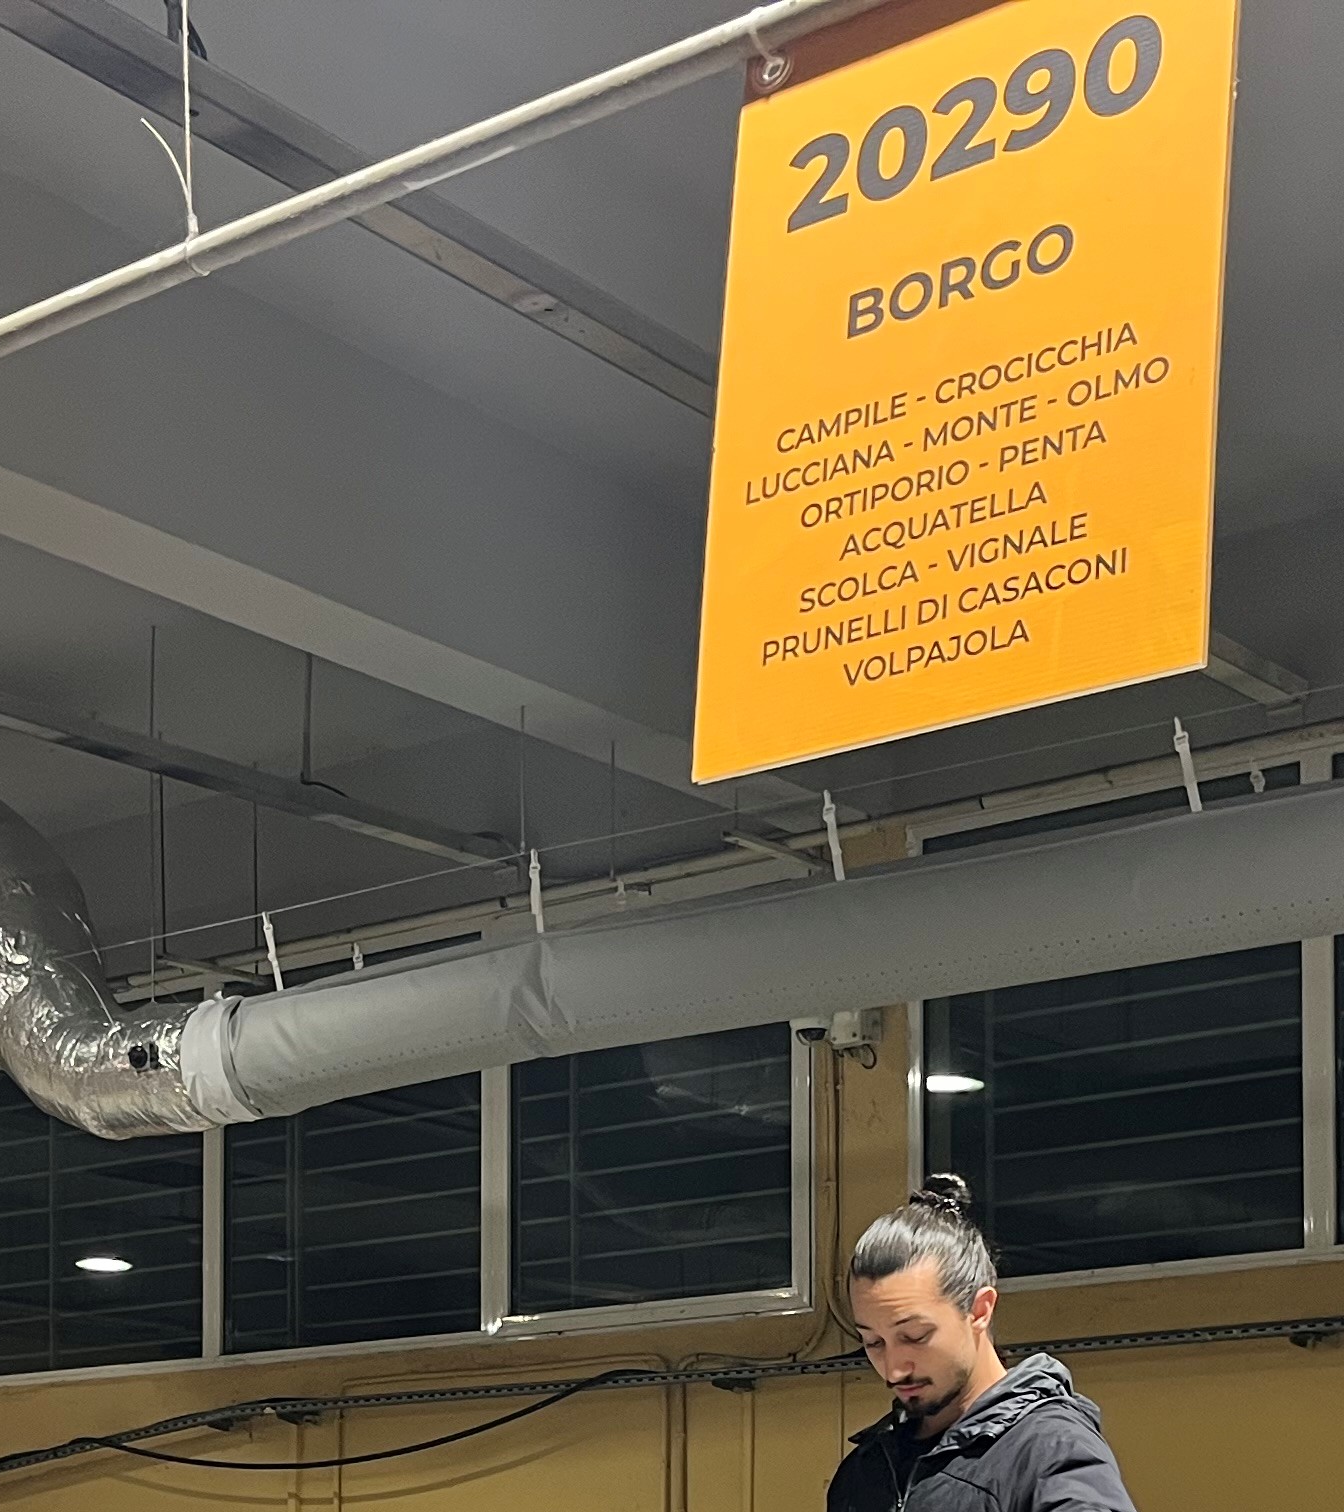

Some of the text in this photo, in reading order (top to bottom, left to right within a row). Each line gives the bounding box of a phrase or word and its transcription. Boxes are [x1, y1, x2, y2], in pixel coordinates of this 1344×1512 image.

[787, 14, 1163, 234] 20290
[847, 223, 1074, 339] BORGO
[745, 440, 895, 506] LUCCIANA
[923, 395, 1038, 453] MONTE
[1066, 356, 1170, 407] OLMO
[776, 392, 908, 454] CAMPILE
[934, 322, 1138, 404] CROCICCHIA
[800, 459, 969, 529] ORTIPORIO
[999, 421, 1107, 473] PENTA
[839, 481, 1048, 561] ACQUATELLA
[762, 547, 1129, 667] PRUNELLI DI CASACONI
[799, 560, 920, 614] SCOLCA
[947, 513, 1088, 573] VIGNALE
[843, 619, 1030, 687] VOLPAJOLA
